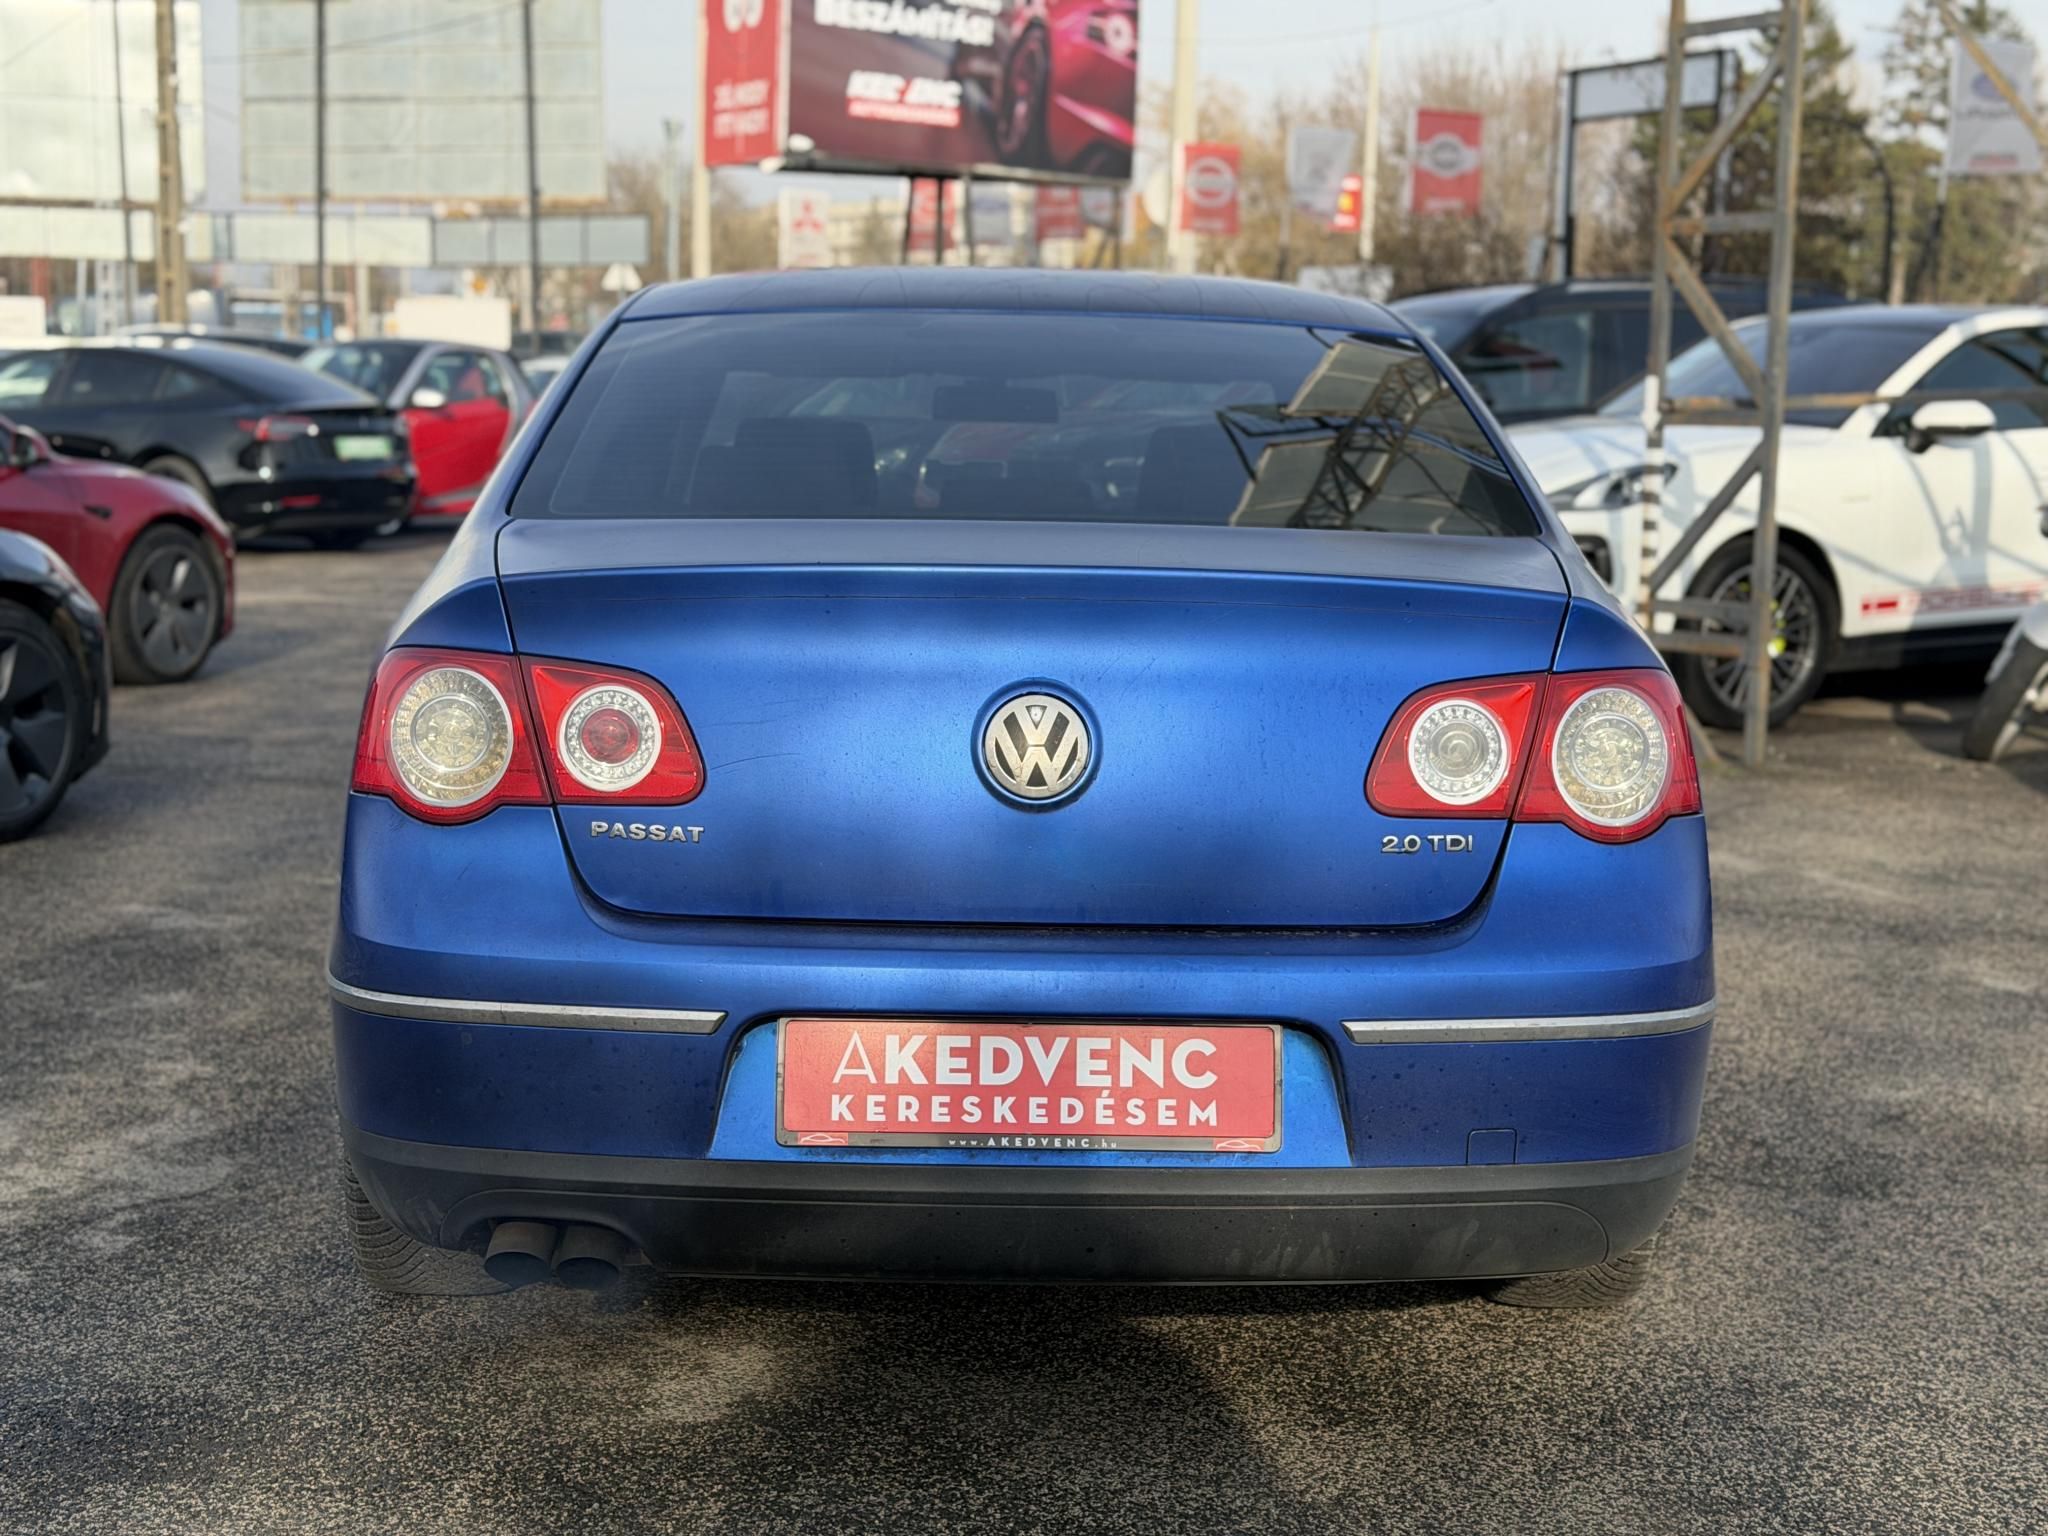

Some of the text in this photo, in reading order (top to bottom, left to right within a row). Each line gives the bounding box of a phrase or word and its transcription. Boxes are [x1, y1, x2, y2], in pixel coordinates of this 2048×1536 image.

[590, 820, 705, 843] PASSAT
[1426, 834, 1473, 852] TDI
[830, 1089, 1219, 1127] KERESKEDÉSEM
